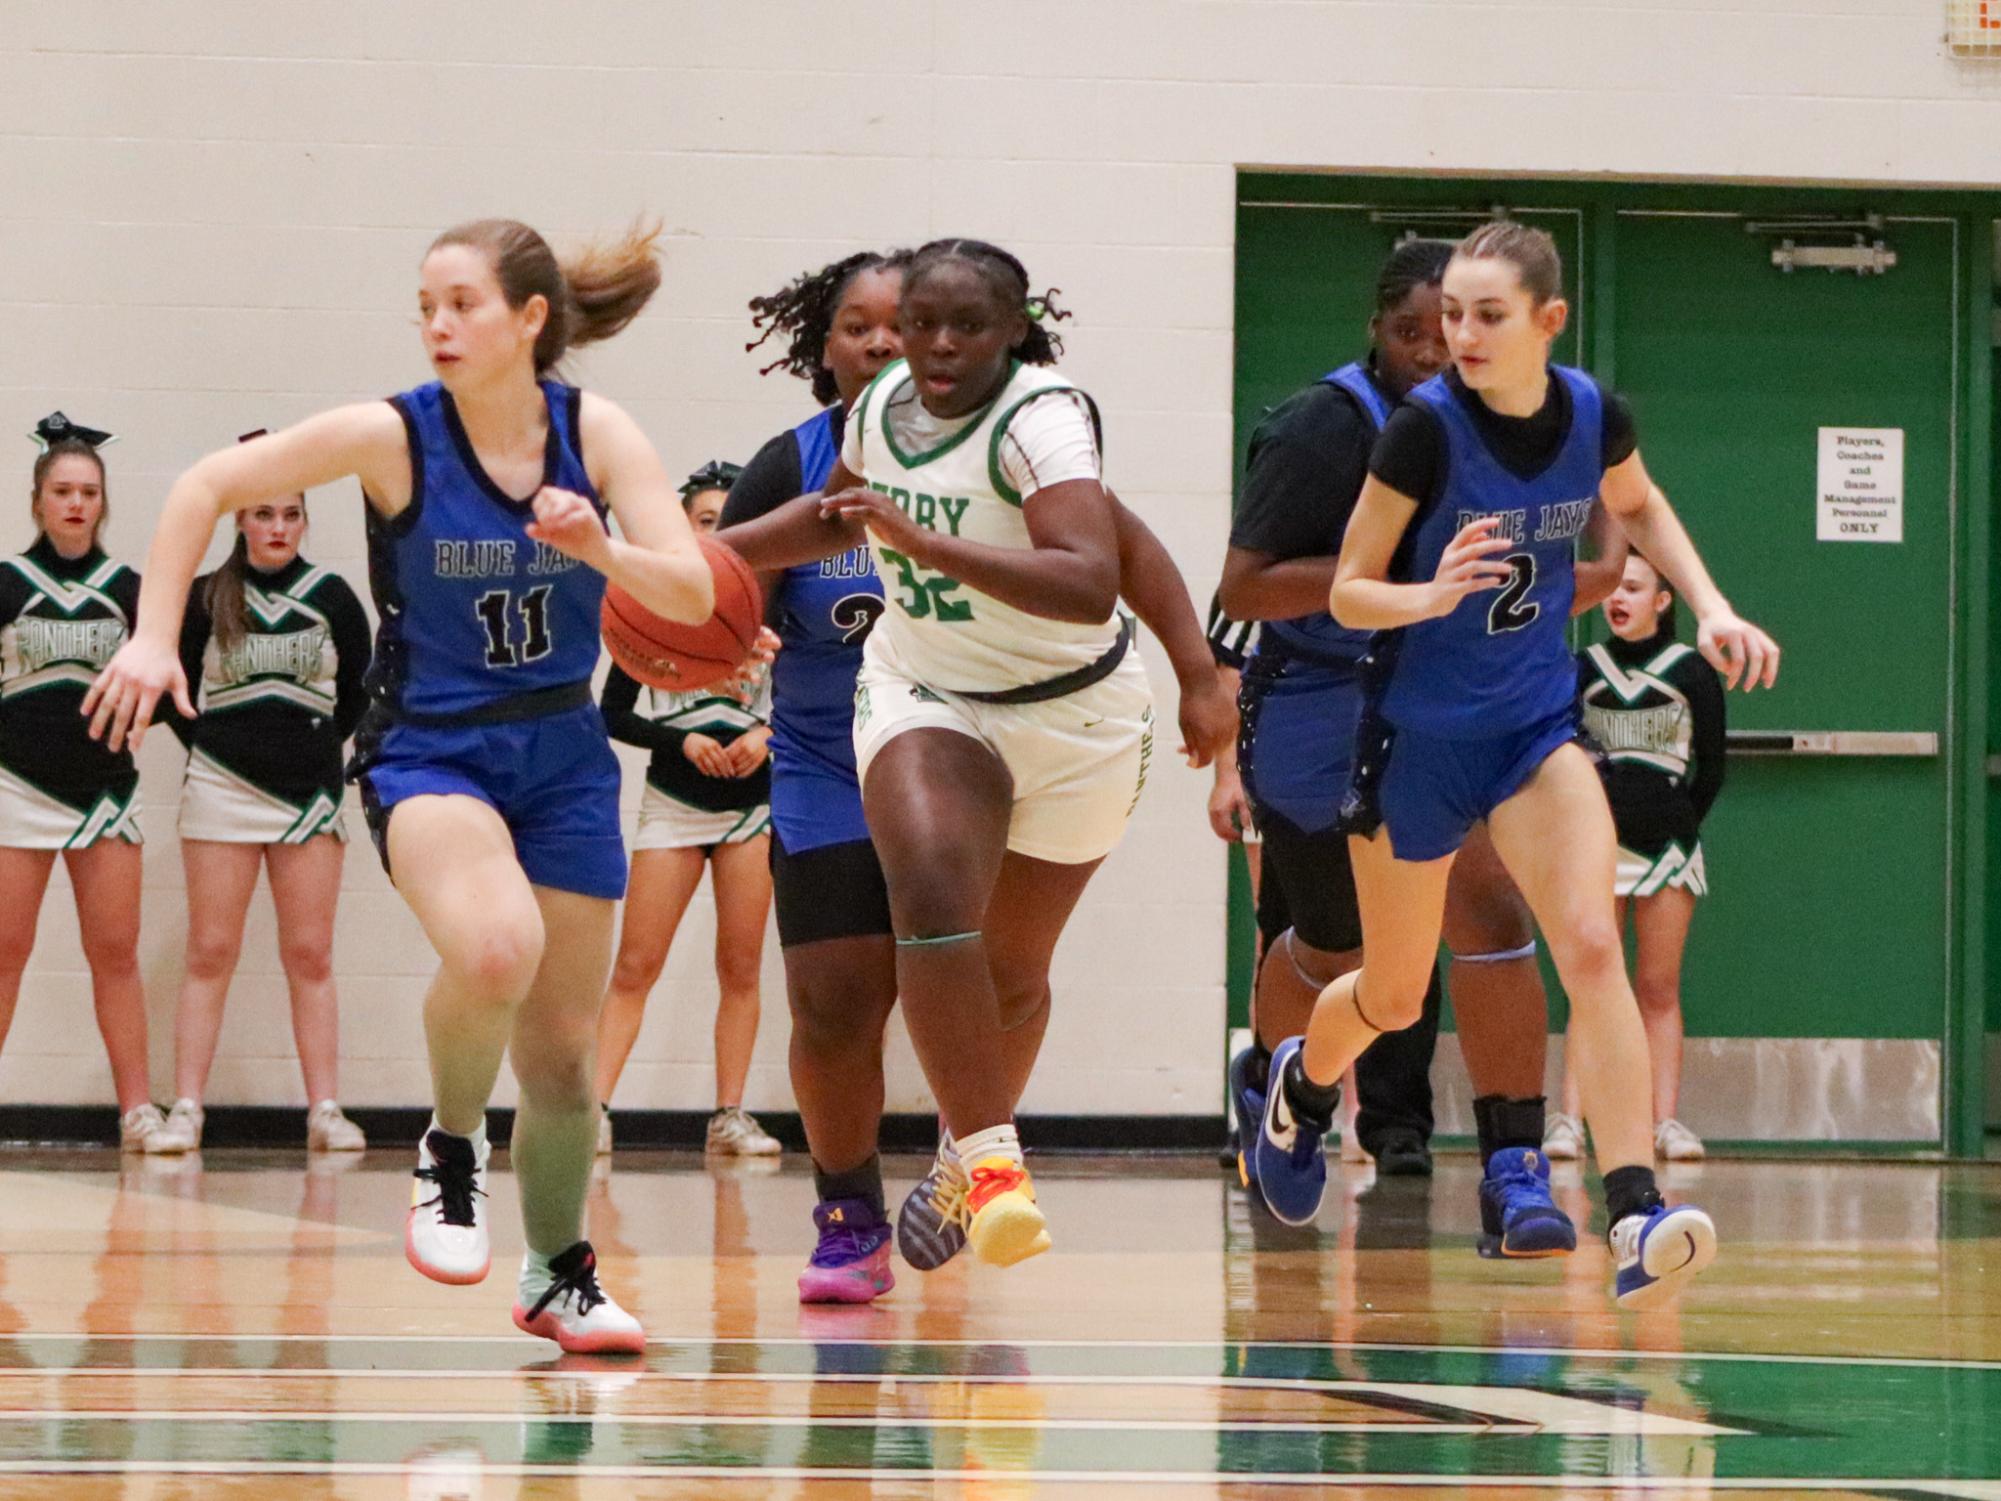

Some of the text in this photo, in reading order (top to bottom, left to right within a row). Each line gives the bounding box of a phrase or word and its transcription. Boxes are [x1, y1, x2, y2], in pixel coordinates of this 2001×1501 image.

[1836, 435, 1884, 448] Players,
[1836, 450, 1884, 461] Coaches
[1849, 466, 1871, 475] and
[1844, 480, 1876, 490] Game
[1823, 494, 1896, 505] Management
[1832, 507, 1887, 518] Personnel
[1839, 522, 1878, 533] ONLY
[434, 539, 516, 578] BLUE
[878, 547, 976, 622] 32
[1487, 553, 1540, 635] 2
[475, 584, 553, 669] 11
